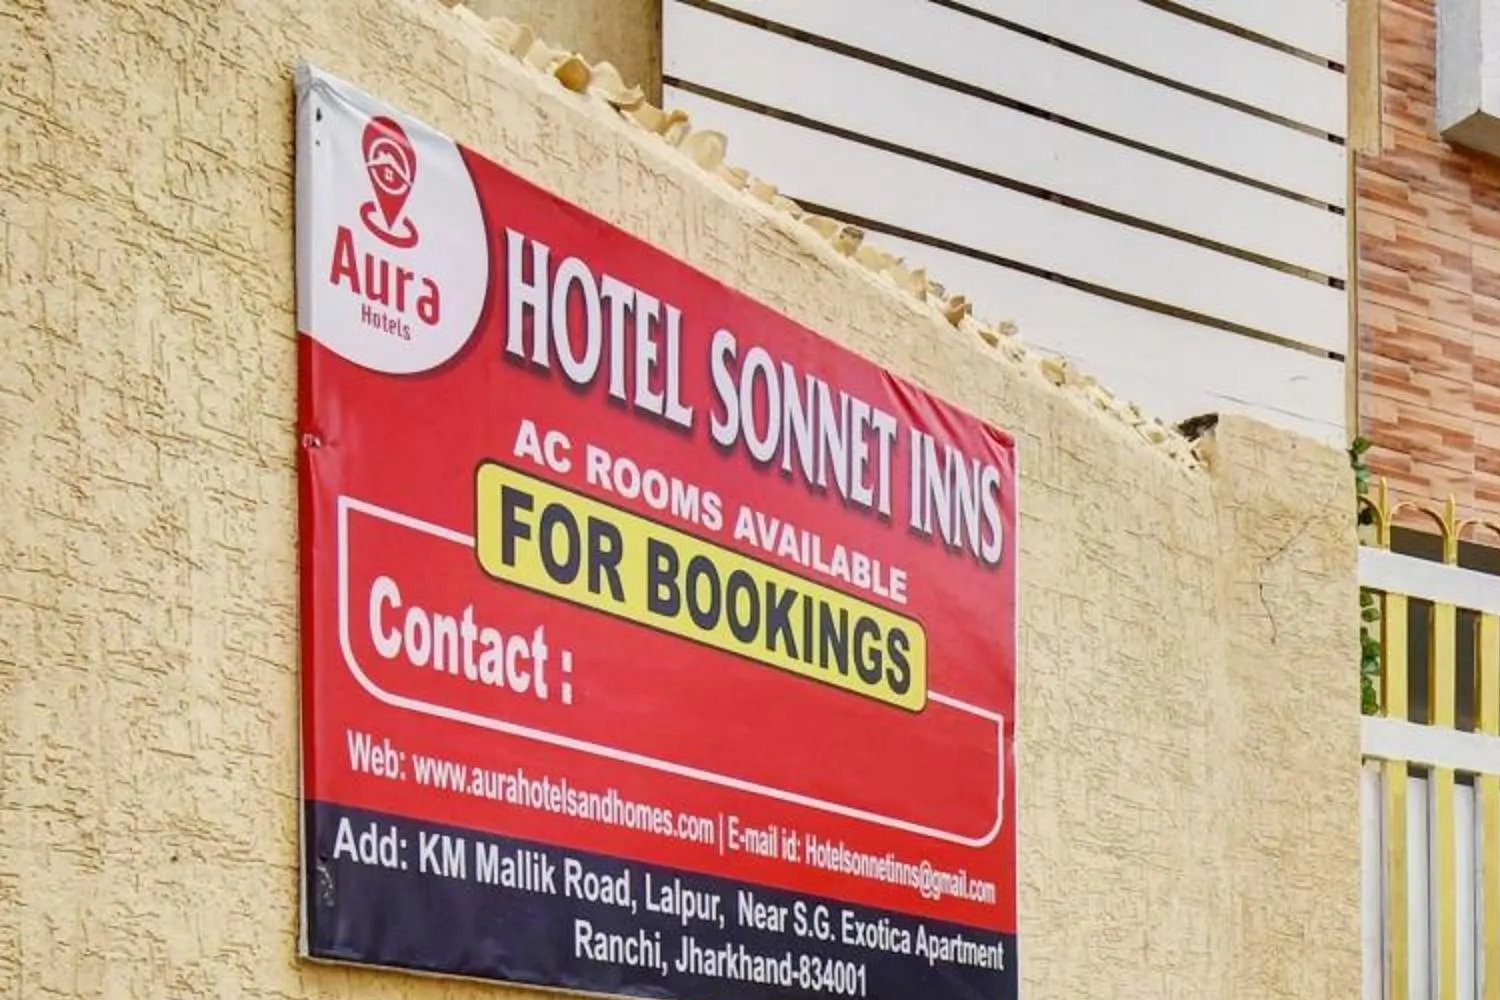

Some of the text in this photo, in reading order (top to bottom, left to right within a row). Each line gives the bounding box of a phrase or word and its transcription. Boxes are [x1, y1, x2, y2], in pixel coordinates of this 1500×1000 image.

[329, 225, 442, 326] Aura
[361, 303, 411, 341] Hotels
[505, 226, 1003, 565] HOTEL SONNET INNS
[513, 419, 908, 605] AC ROOMS AVAILABLE
[501, 484, 912, 696] FOR BOOKINGS
[347, 729, 406, 781] Web:
[412, 753, 714, 845] www.aurahotelsandhomes.com
[728, 814, 778, 859] E-mail
[781, 827, 802, 864] id:
[333, 816, 1005, 972] Add: KM Mallik Road, Lalpur, Near S.G. Exotica Apartment
[574, 918, 867, 998] Ranchi, Jharkhand-834001
